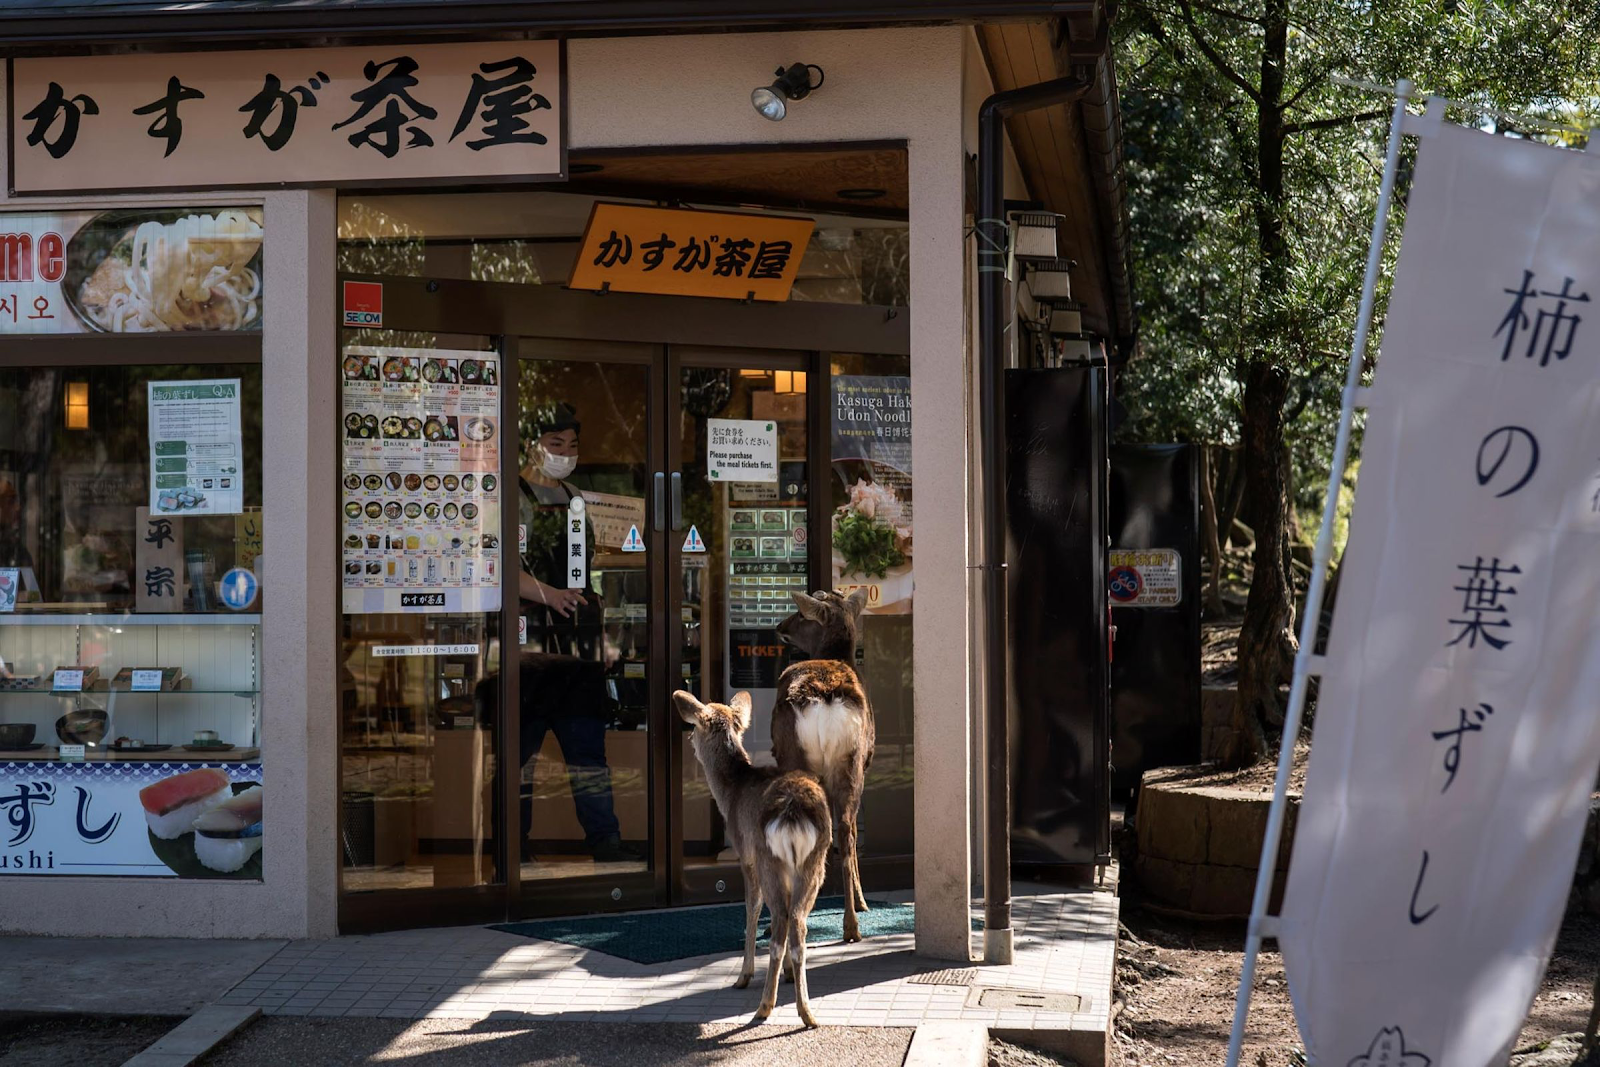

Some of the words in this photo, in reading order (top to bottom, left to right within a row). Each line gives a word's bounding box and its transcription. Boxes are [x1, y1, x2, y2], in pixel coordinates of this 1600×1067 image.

[22, 56, 552, 159] かすが茶屋
[0, 232, 67, 282] me
[593, 230, 793, 279] かすが茶屋
[0, 294, 55, 323] 시오
[346, 312, 380, 323] SECOM
[837, 393, 884, 410] Kasuga
[888, 395, 911, 408] Hak
[837, 408, 871, 421] Udon
[874, 409, 911, 423] Noodl
[712, 427, 743, 436] 先に食券を
[712, 437, 772, 446] お買い求めください。
[709, 450, 727, 459] Please
[728, 451, 753, 460] purchase
[716, 460, 726, 468] the
[727, 460, 740, 468] meal
[741, 461, 760, 469] tickets
[760, 461, 774, 469] first.
[571, 519, 582, 581] 営業中
[735, 564, 778, 573] かすが茶屋
[402, 594, 444, 605] かすが茶屋
[1408, 269, 1591, 927] 柿の葉ずし
[737, 644, 785, 657] TICKET
[0, 782, 120, 846] ずし
[0, 850, 54, 869] ushi
